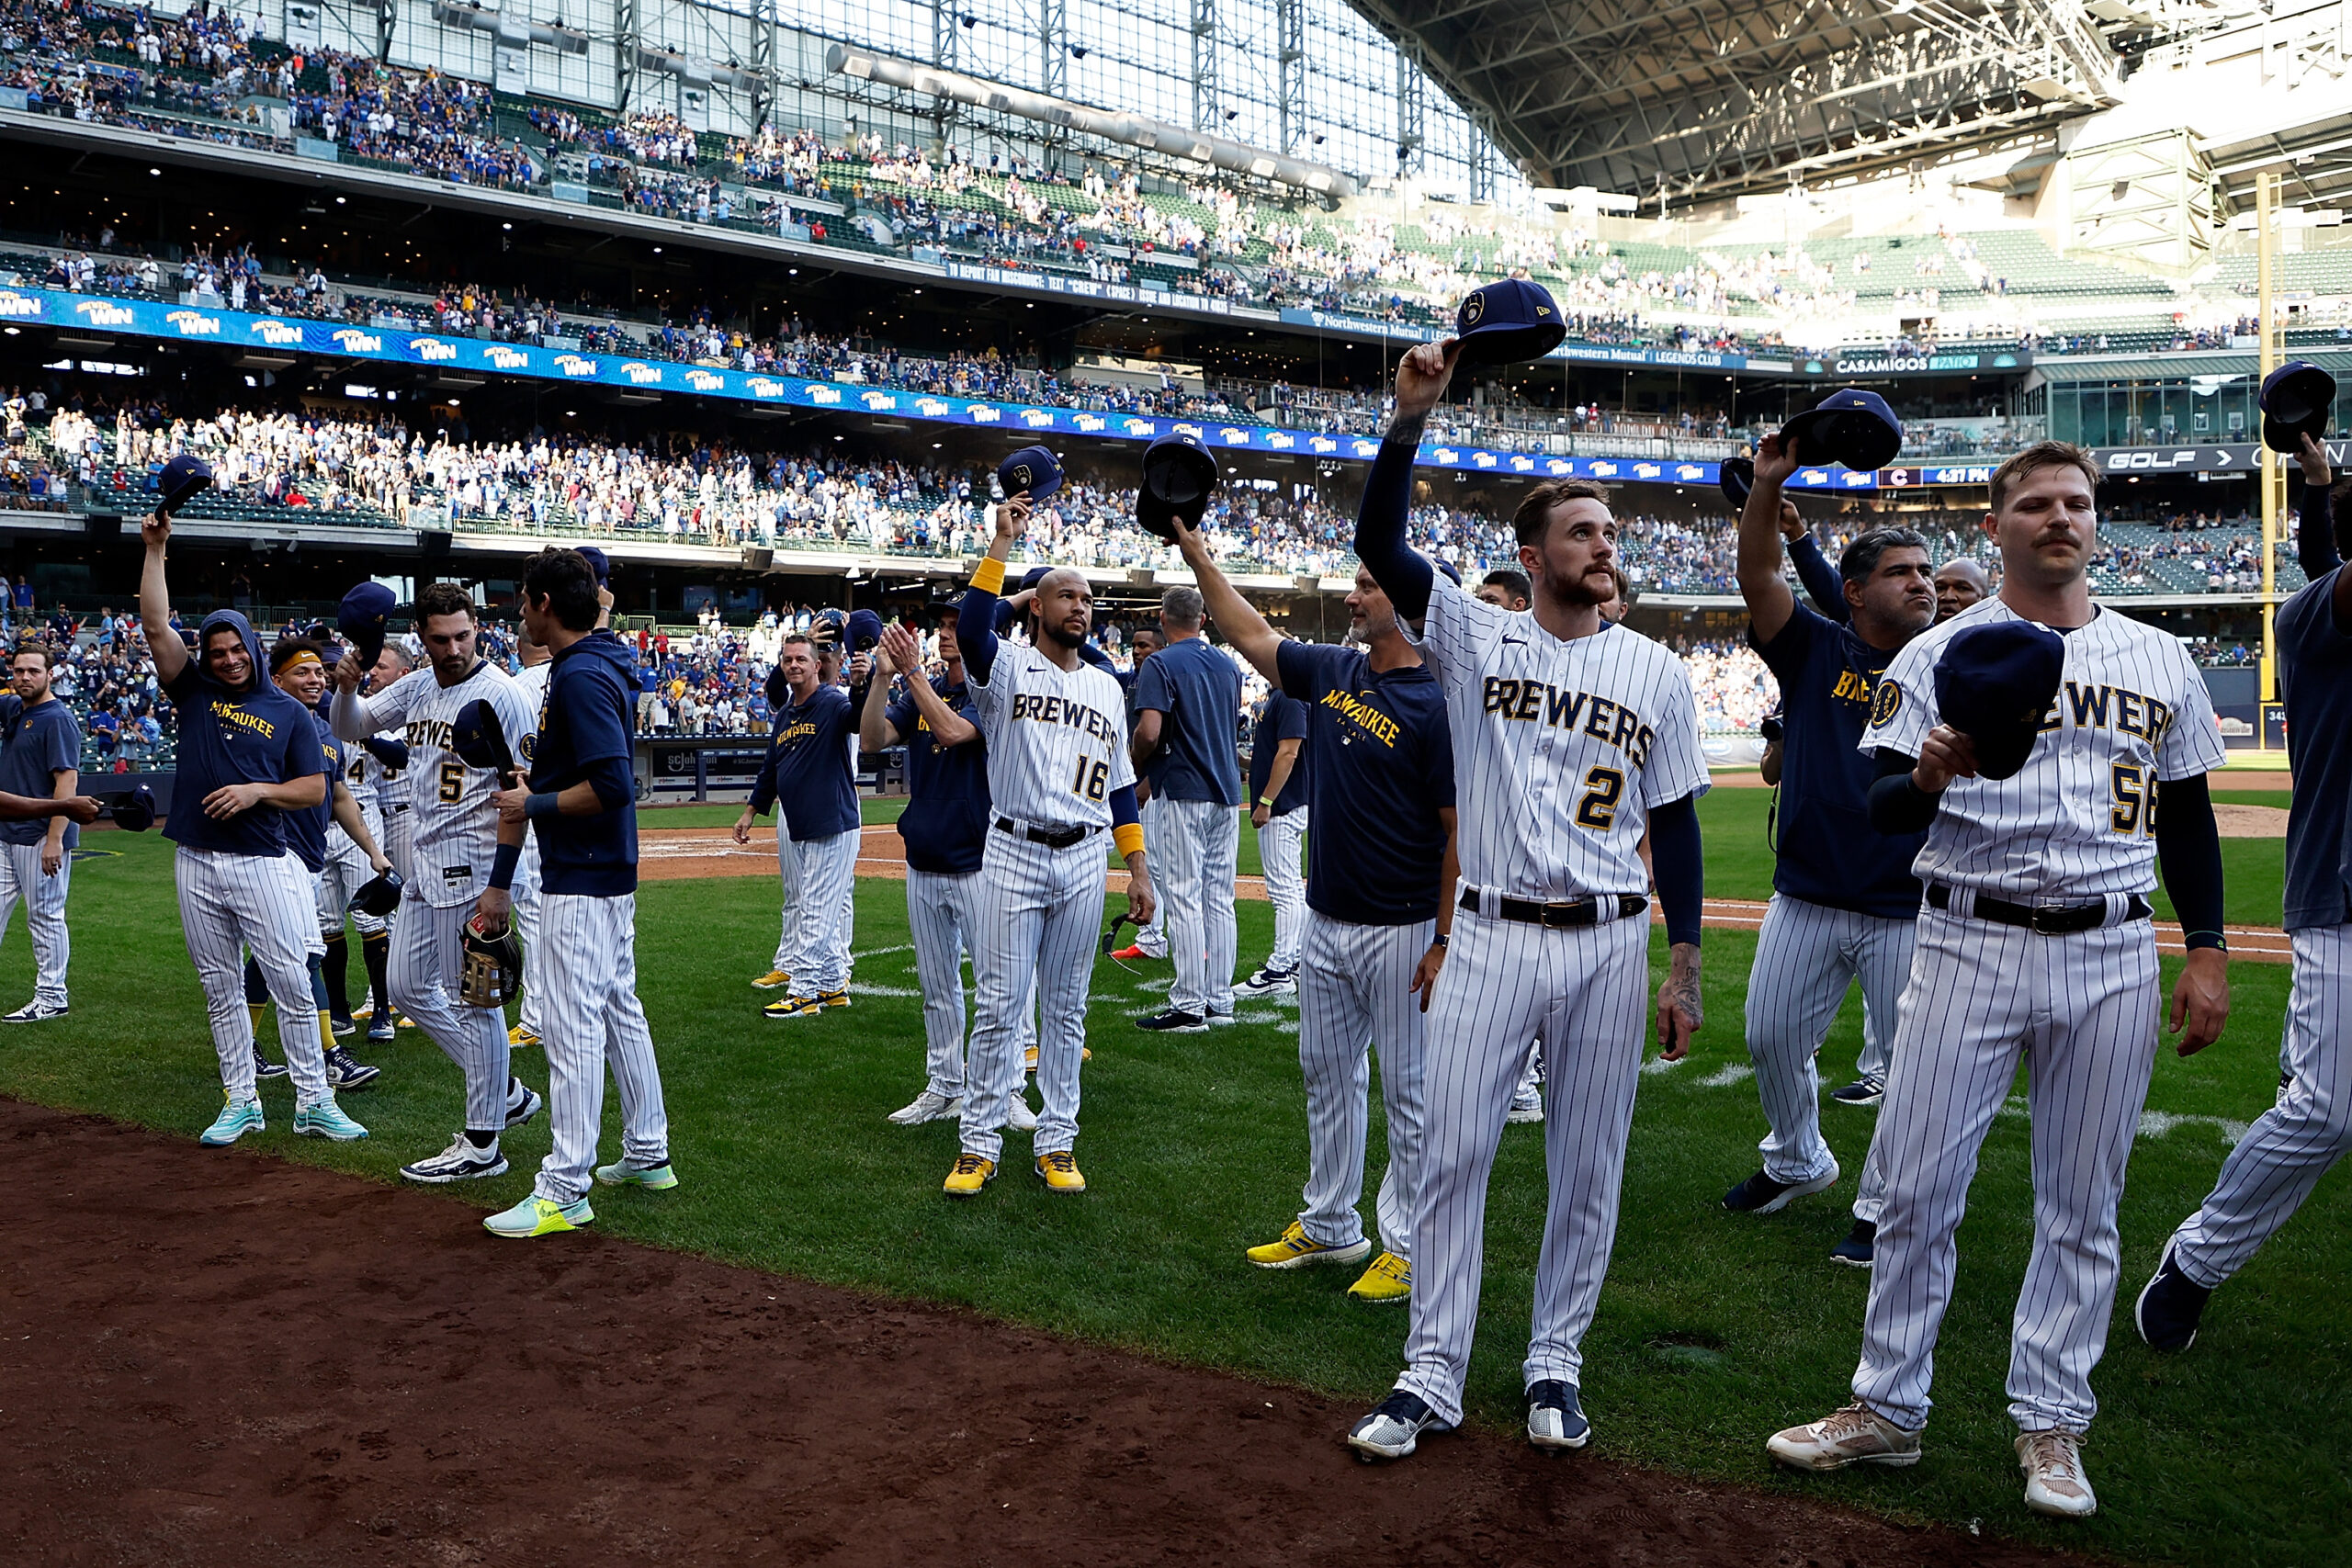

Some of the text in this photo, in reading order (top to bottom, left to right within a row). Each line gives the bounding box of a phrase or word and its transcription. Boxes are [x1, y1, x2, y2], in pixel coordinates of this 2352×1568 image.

[960, 264, 985, 280] REPORT
[1048, 276, 1064, 291] TEXT
[1139, 289, 1157, 305] ISSUE
[1159, 291, 1171, 306] AND
[1172, 293, 1199, 310] LOCATION
[90, 309, 133, 325] WIN
[179, 318, 220, 335] WIN
[1324, 316, 1388, 335] Northwestern
[1390, 323, 1422, 339] Mutual
[263, 327, 302, 343] WIN
[343, 336, 381, 352] WIN
[421, 345, 456, 360] WIN
[494, 353, 528, 368] WIN
[1548, 346, 1721, 367] orthwestern Mutual LEGENDS CLUB
[564, 361, 596, 376] WIN
[1836, 357, 1928, 374] CASAMIGOS
[630, 369, 662, 383] WIN
[694, 376, 724, 390] WIN
[755, 383, 783, 397] WIN
[814, 390, 841, 403] WIN
[869, 397, 896, 410] WIN
[923, 403, 948, 416] WIN
[973, 409, 1000, 422] WIN
[1028, 414, 1053, 427] WIN
[1080, 418, 1105, 431] WIN
[1130, 423, 1155, 436] WIN
[2108, 451, 2196, 469] GOLF
[1890, 468, 1908, 486] C
[1968, 468, 1990, 482] PM
[1484, 676, 1655, 772] BREWERS
[2037, 681, 2174, 755] EWER
[1012, 694, 1118, 760] BREWERS
[404, 719, 458, 755] REWE
[439, 762, 466, 803] 5
[1072, 754, 1109, 803] 16
[1575, 765, 1625, 830] 2
[2111, 762, 2159, 838] 56
